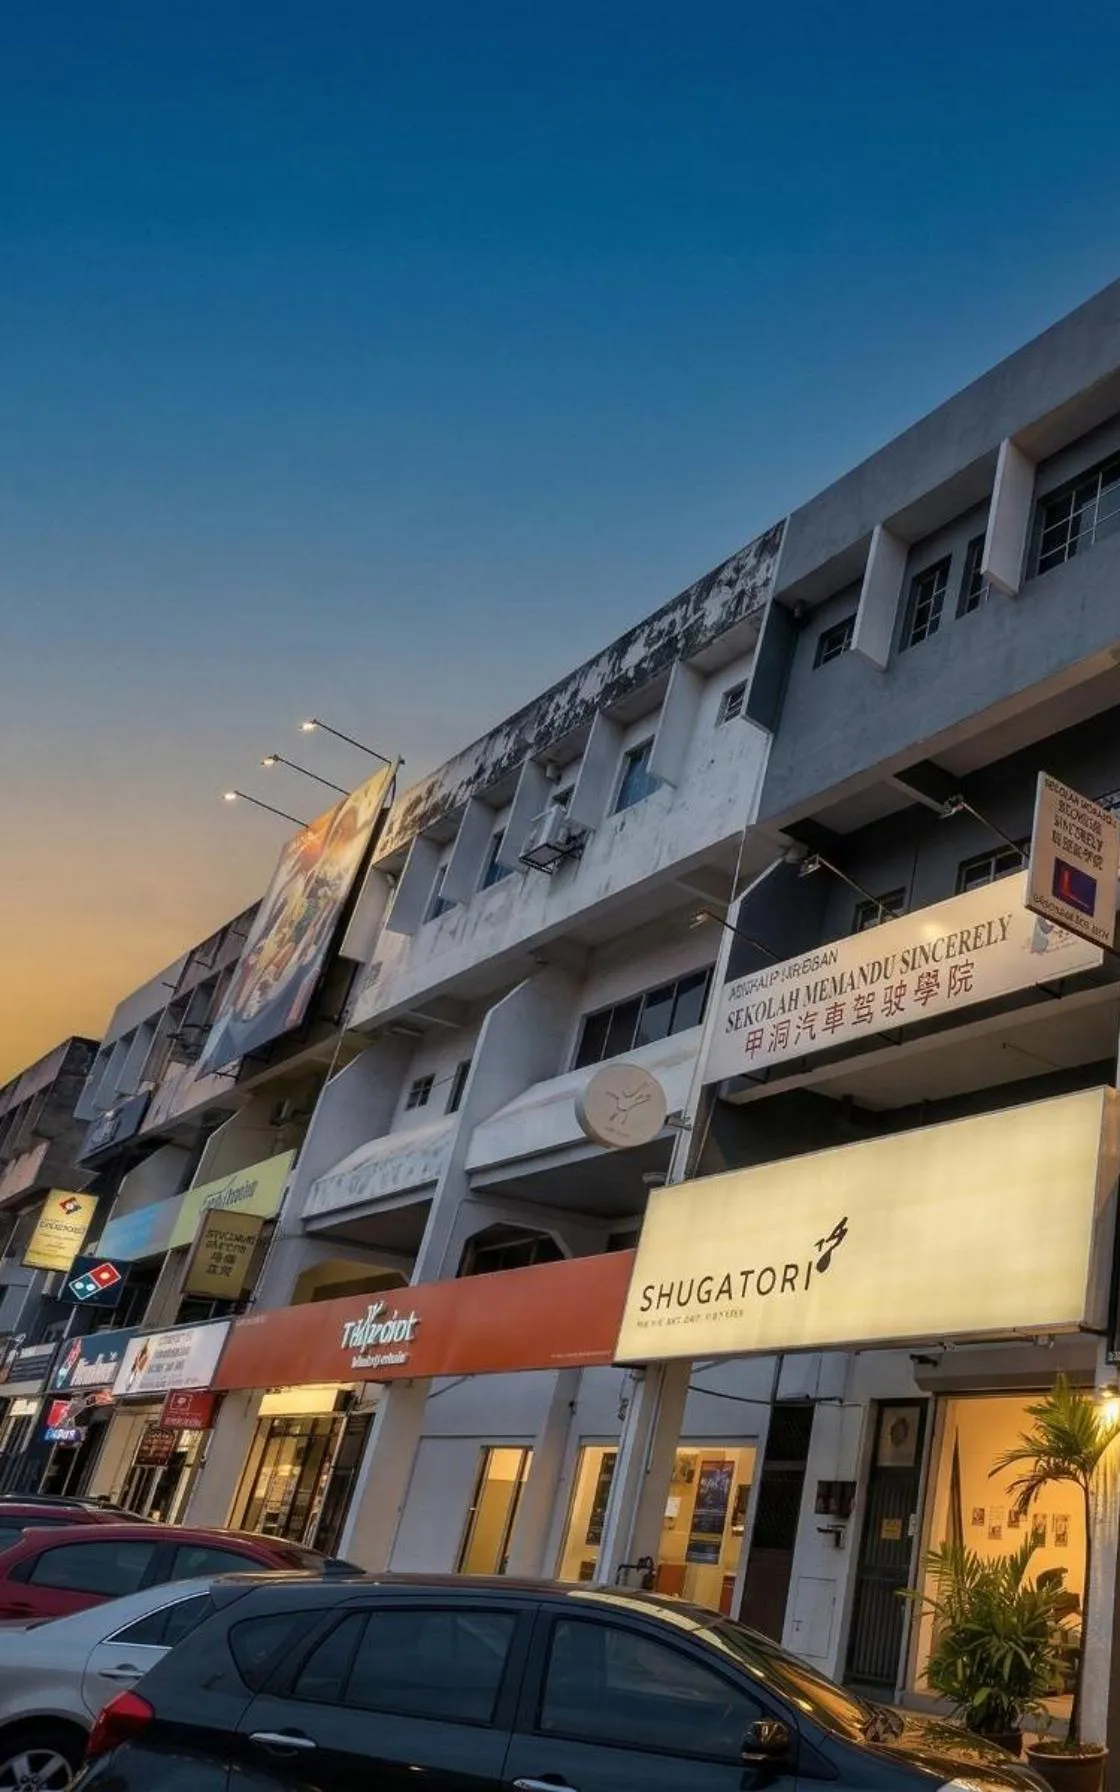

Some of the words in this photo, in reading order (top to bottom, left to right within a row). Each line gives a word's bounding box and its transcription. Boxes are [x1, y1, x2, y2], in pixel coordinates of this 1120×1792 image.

[726, 983, 799, 1034] SEKOLAH
[802, 954, 896, 1006] MEMANDU
[899, 914, 1013, 974] SINCERELY
[639, 1261, 812, 1313] SHUGATORI
